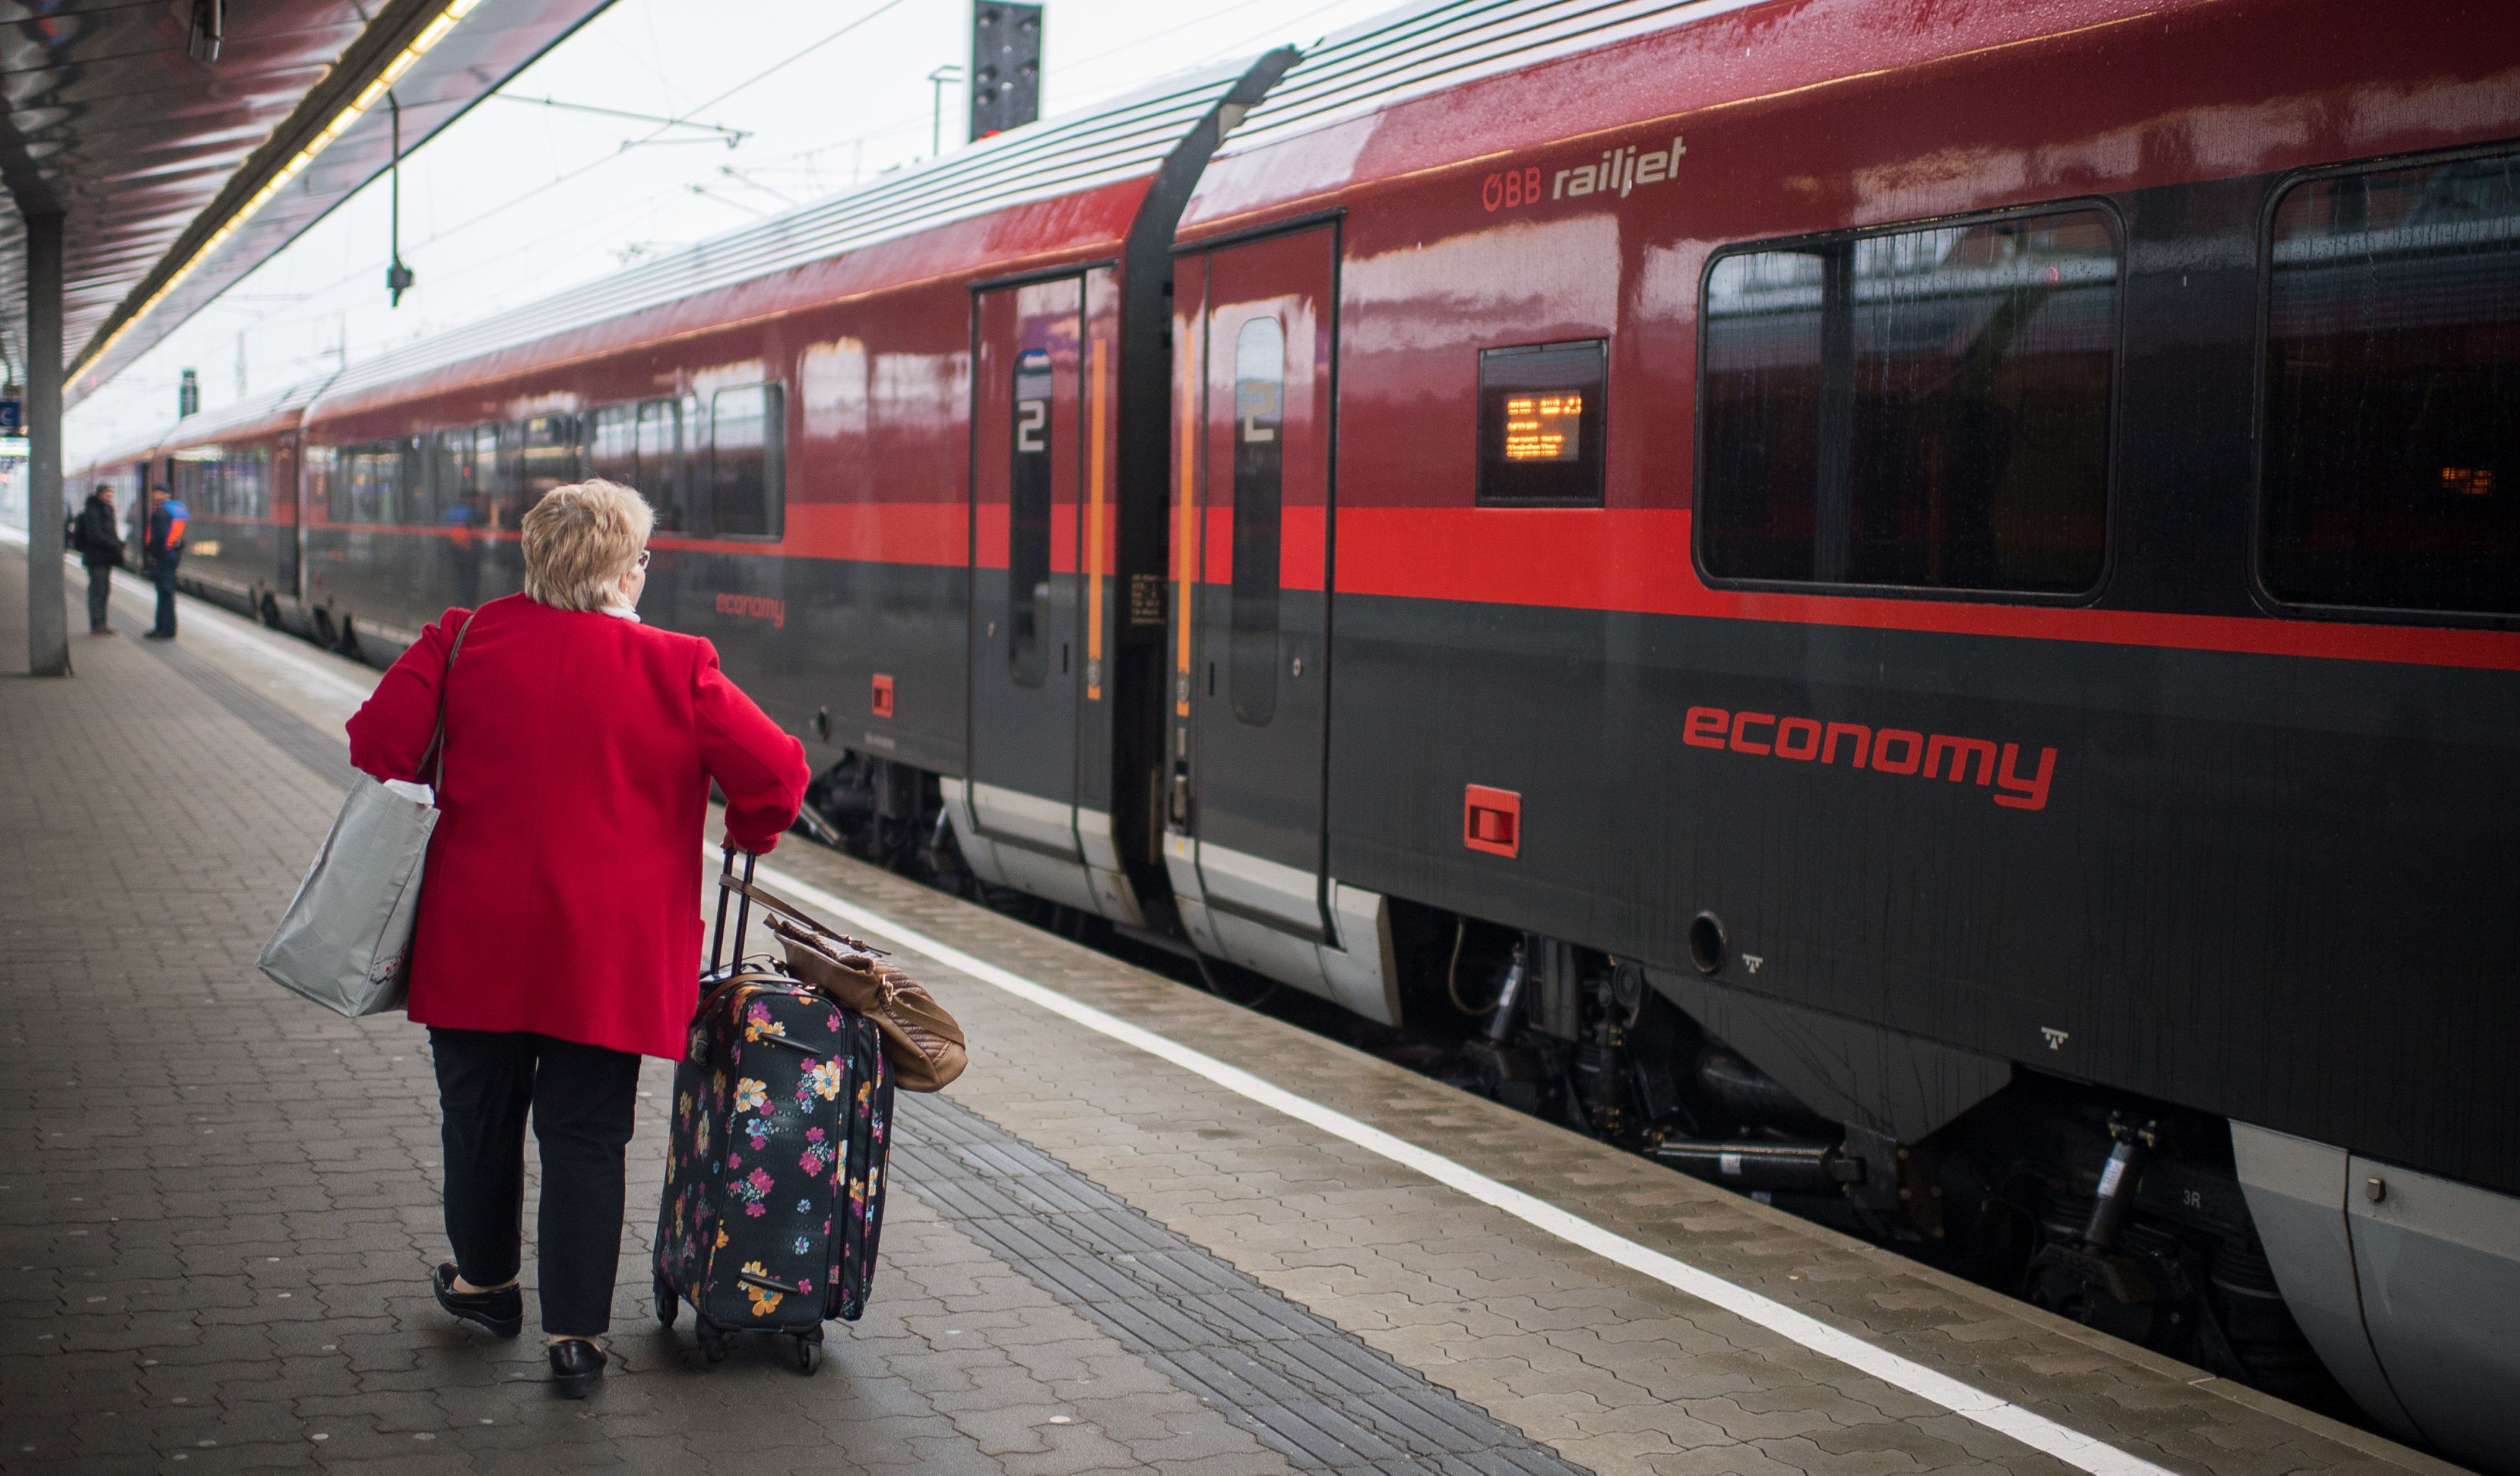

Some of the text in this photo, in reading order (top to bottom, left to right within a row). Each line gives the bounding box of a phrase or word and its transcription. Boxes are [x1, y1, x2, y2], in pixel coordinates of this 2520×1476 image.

[1482, 135, 1687, 212] ÖBB railjet
[1018, 400, 1045, 451] 2
[1243, 381, 1274, 441] 2
[1683, 706, 2058, 811] economy
[2183, 1189, 2201, 1209] 3R
